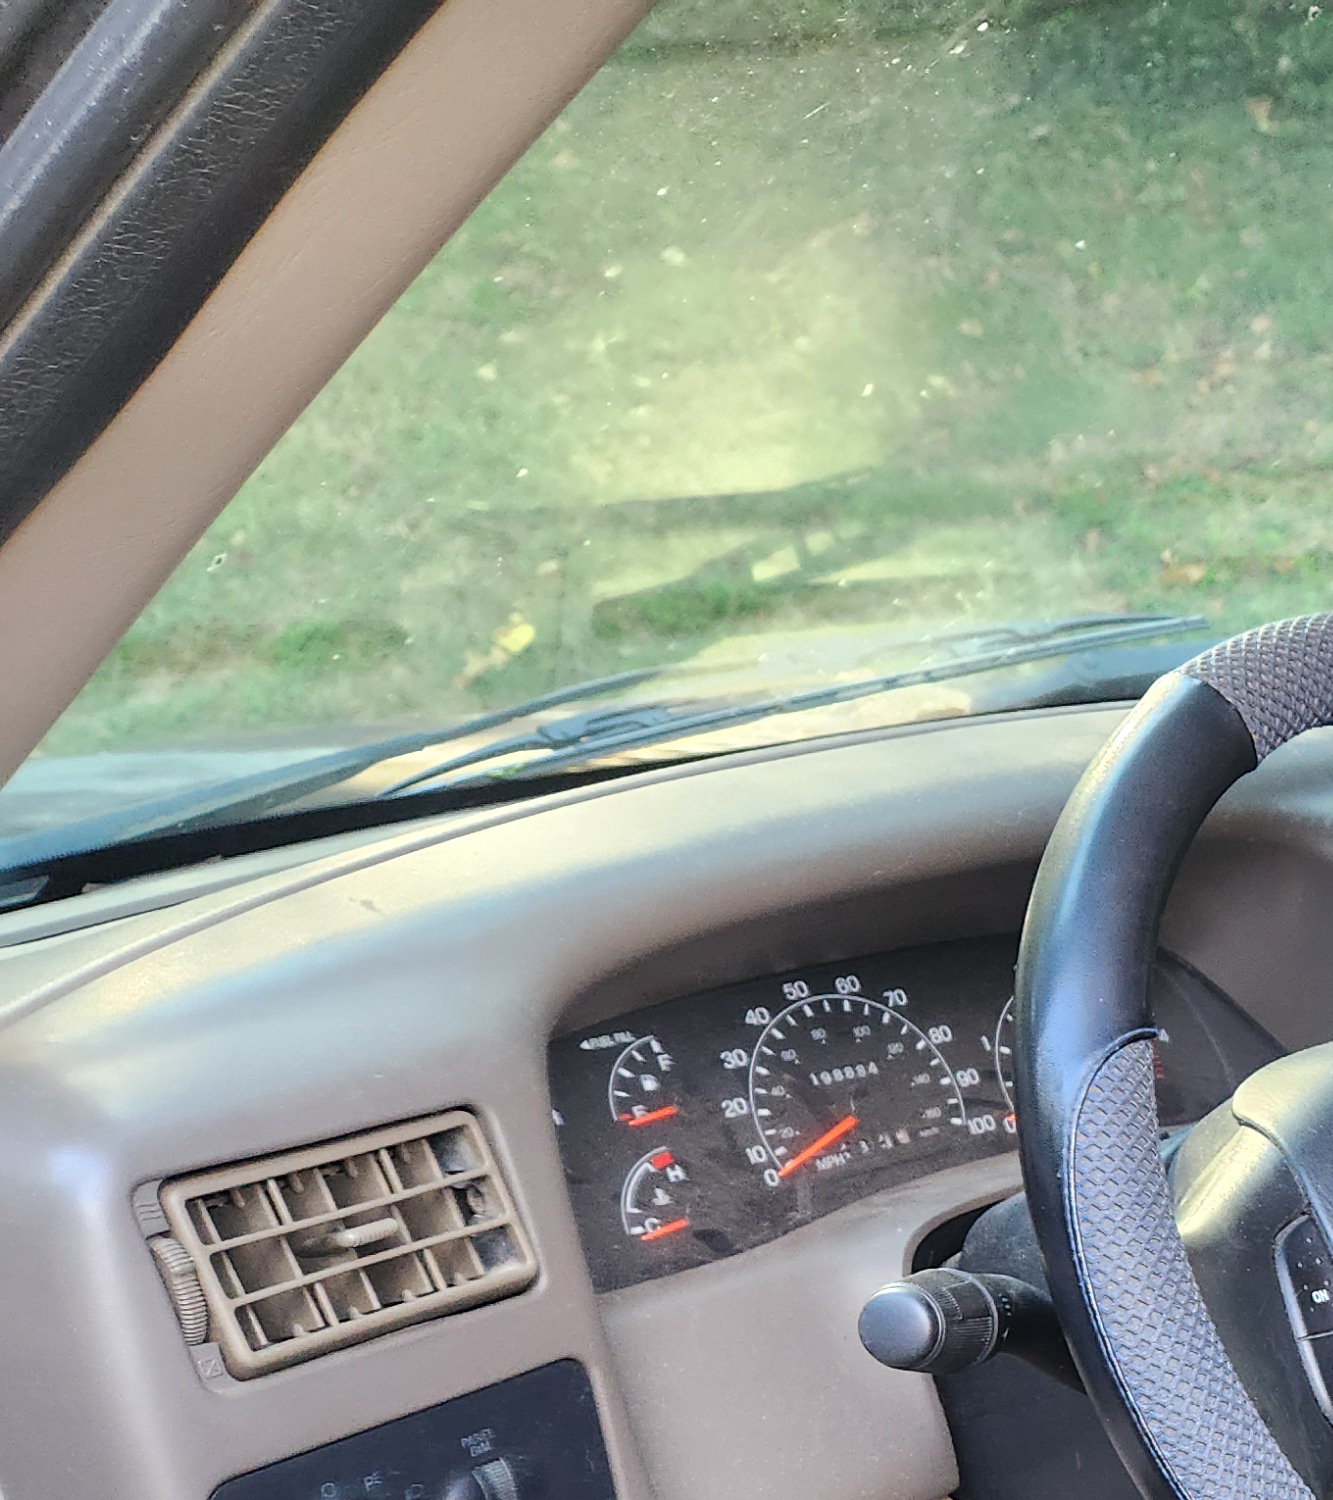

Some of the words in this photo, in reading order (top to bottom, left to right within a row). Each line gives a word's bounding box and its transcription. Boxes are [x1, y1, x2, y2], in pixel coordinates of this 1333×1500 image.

[782, 979, 810, 1000] 50
[835, 975, 861, 993] 60
[883, 988, 909, 1007] 70
[745, 1007, 770, 1025] 40
[928, 1025, 953, 1044] 80
[720, 1048, 748, 1069] 30
[721, 1097, 748, 1118] 20
[967, 1114, 996, 1134] 100
[745, 1145, 768, 1165] 10
[666, 1163, 690, 1182] H
[763, 1168, 780, 1187] 0
[1311, 1288, 1331, 1304] ON
